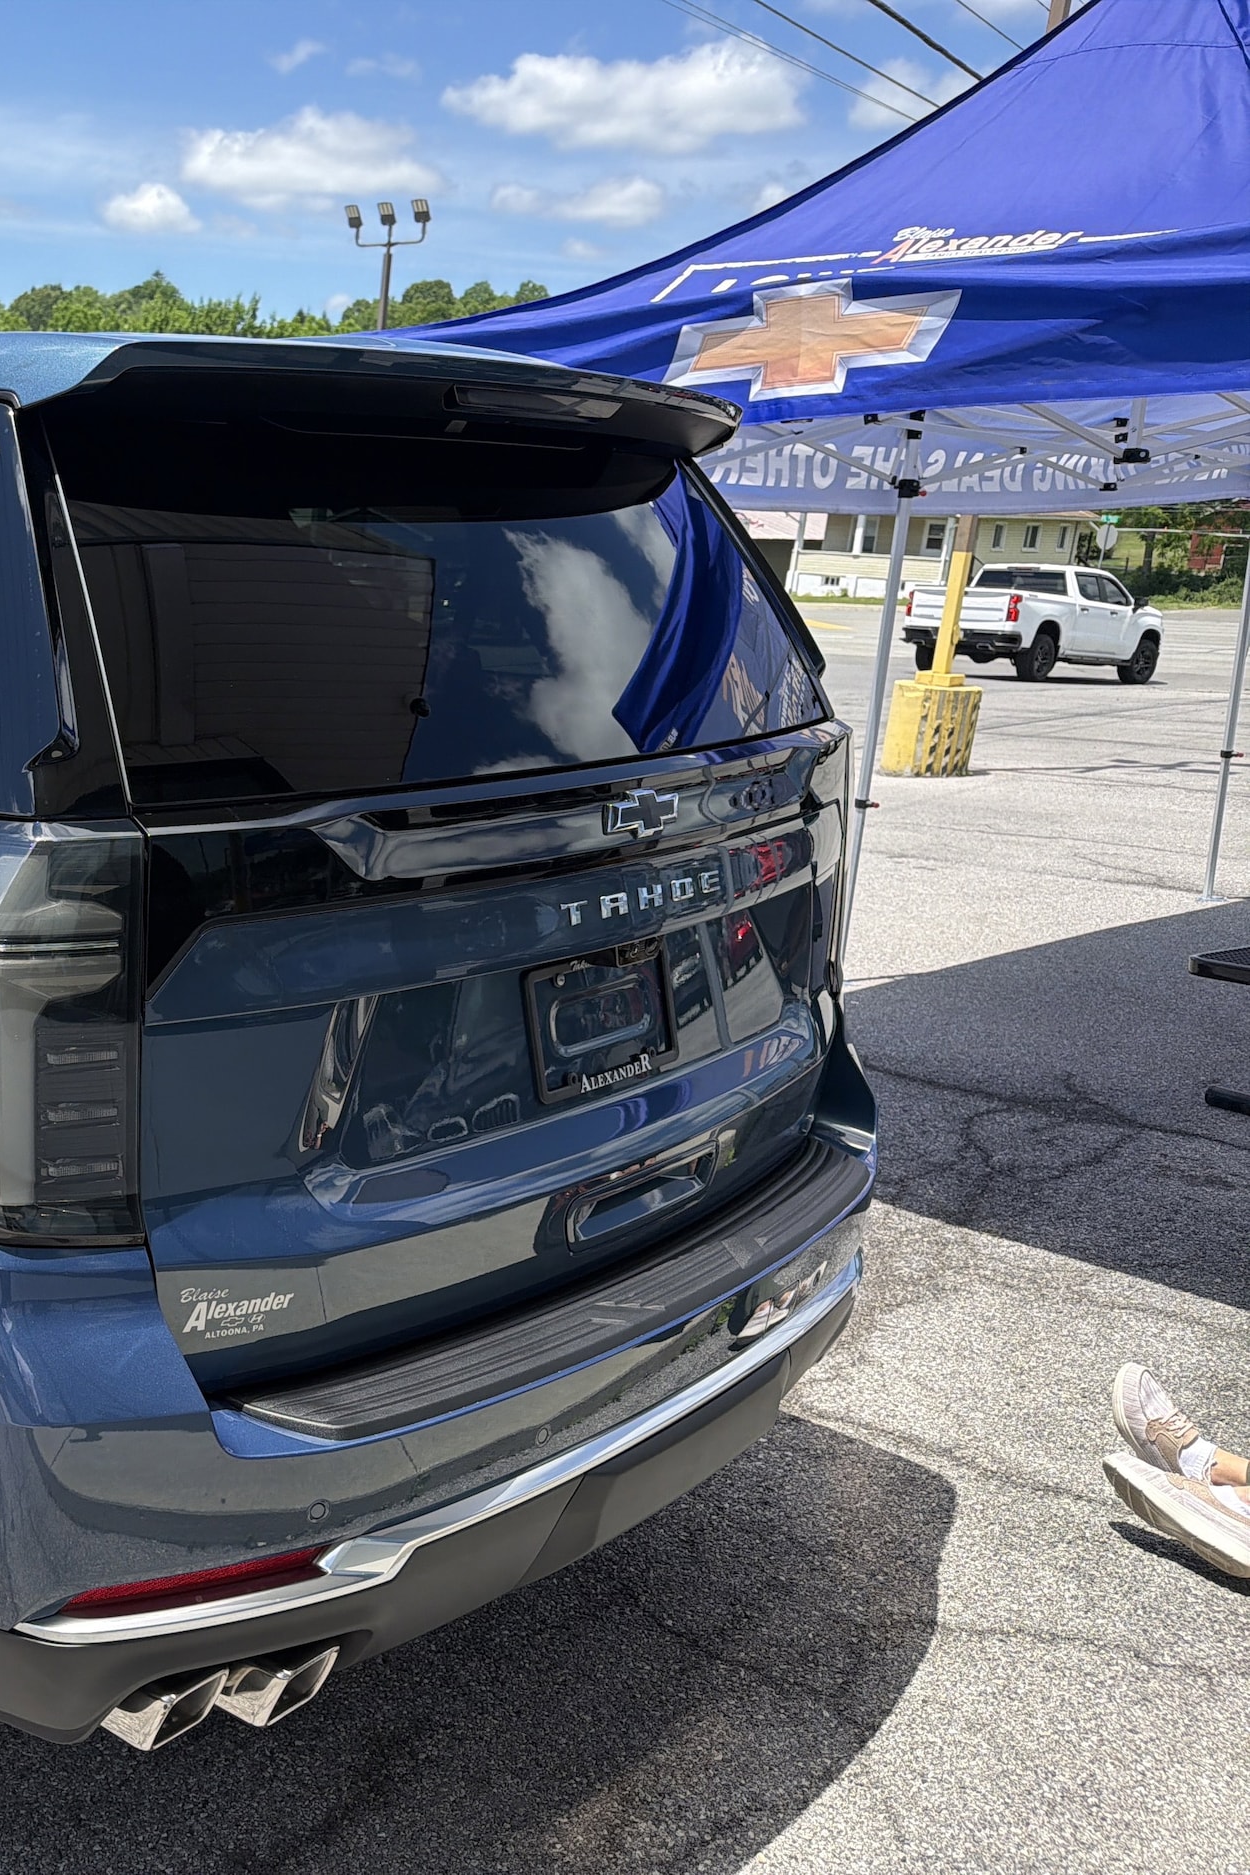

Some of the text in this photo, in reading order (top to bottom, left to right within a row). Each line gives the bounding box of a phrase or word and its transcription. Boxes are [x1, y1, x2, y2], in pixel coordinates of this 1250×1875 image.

[870, 230, 1084, 265] Alexander
[893, 226, 955, 242] Blaise
[560, 870, 721, 926] TAHOE
[581, 1053, 652, 1093] ALEXANDER
[180, 1287, 229, 1303] Blaise
[182, 1292, 295, 1333] Alexander
[204, 1323, 264, 1340] ALTOONA, PA
